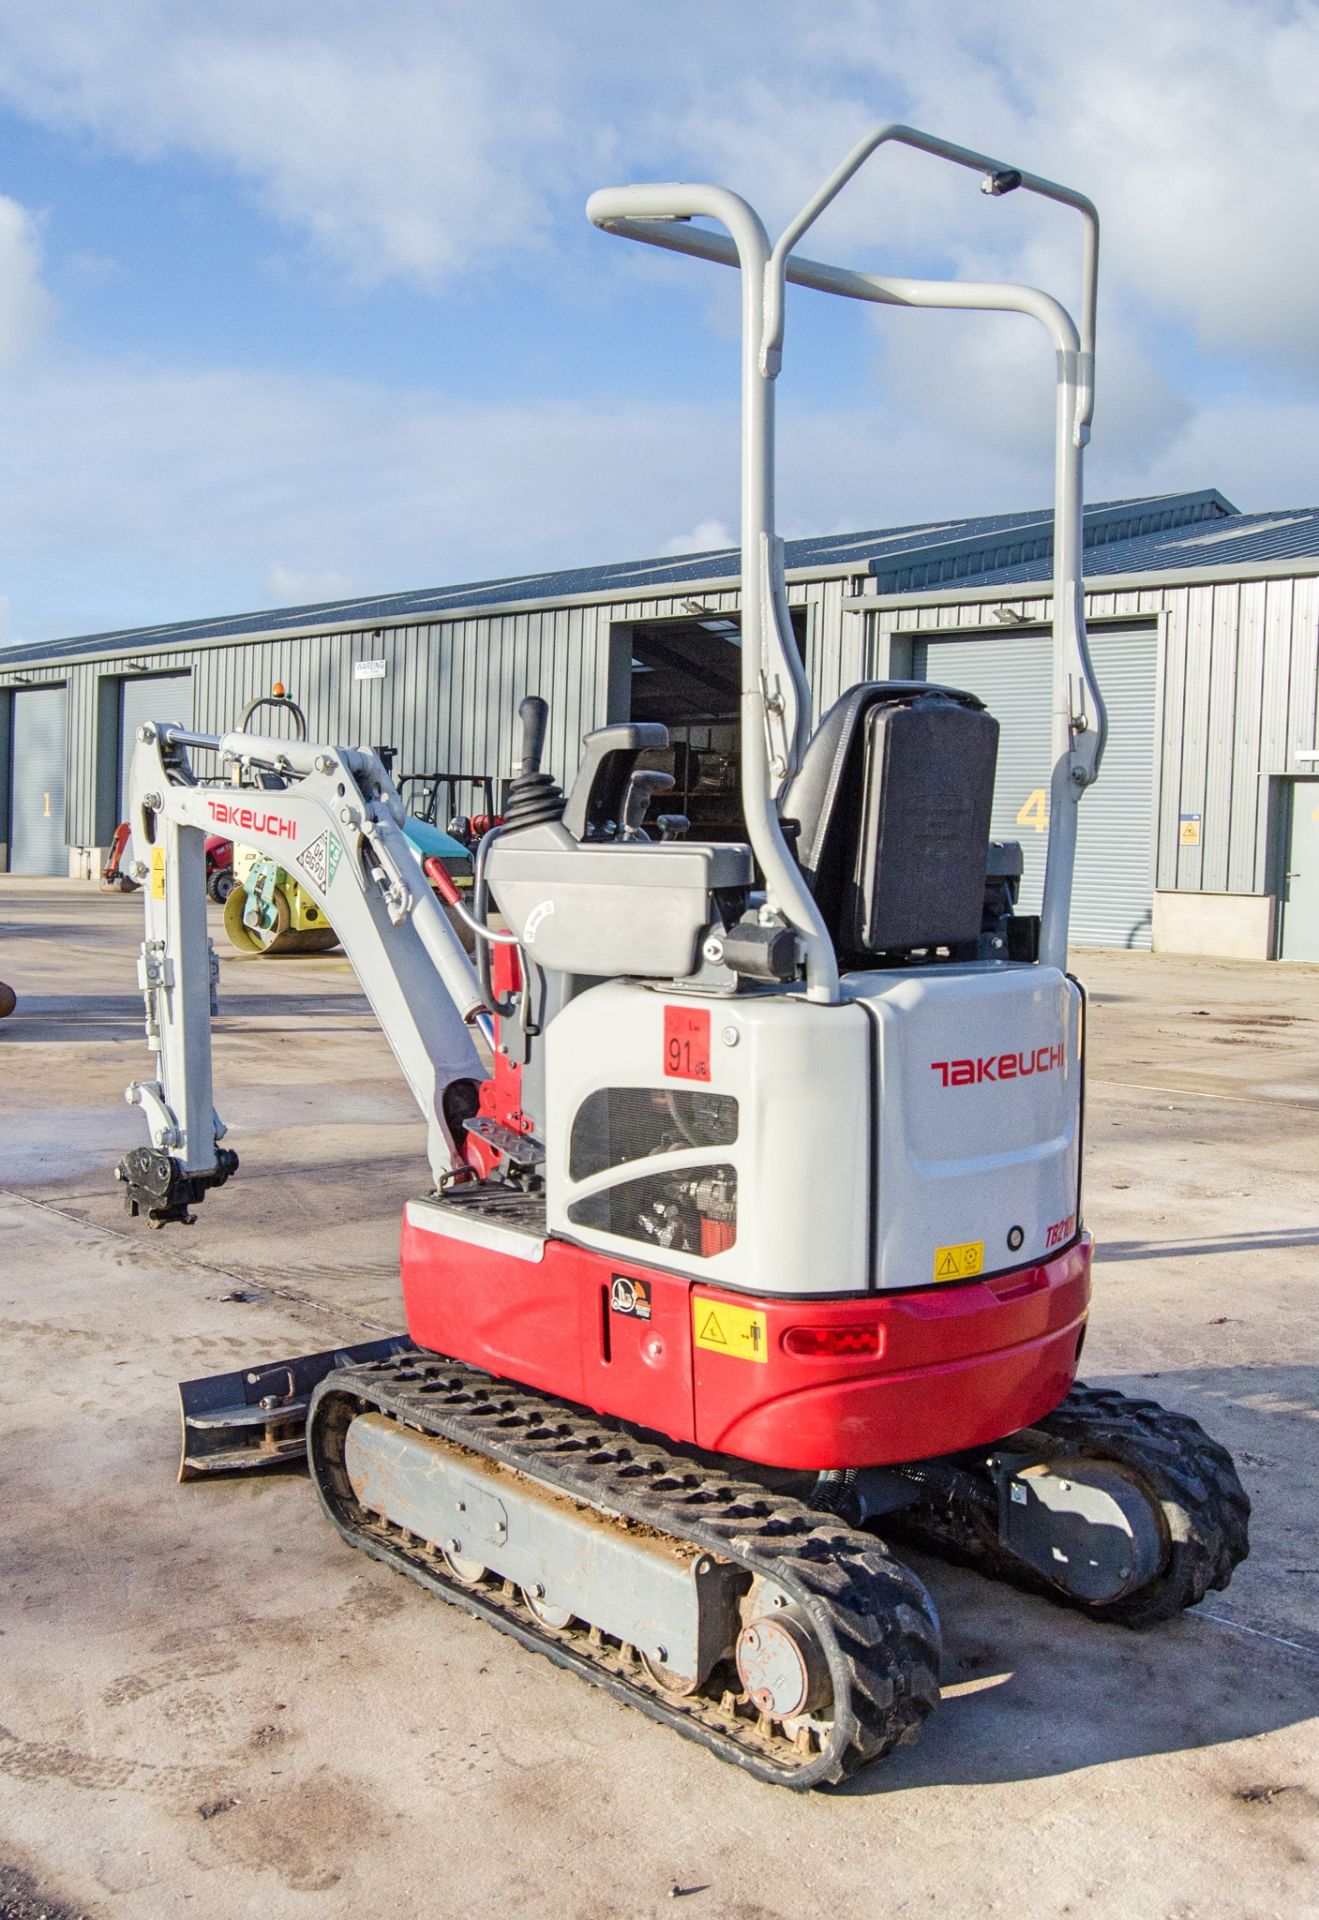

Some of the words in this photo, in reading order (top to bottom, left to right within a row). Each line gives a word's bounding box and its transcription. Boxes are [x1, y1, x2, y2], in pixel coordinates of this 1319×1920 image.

[43, 792, 51, 817] 1
[1017, 788, 1050, 832] 4
[669, 1038, 691, 1073] 91
